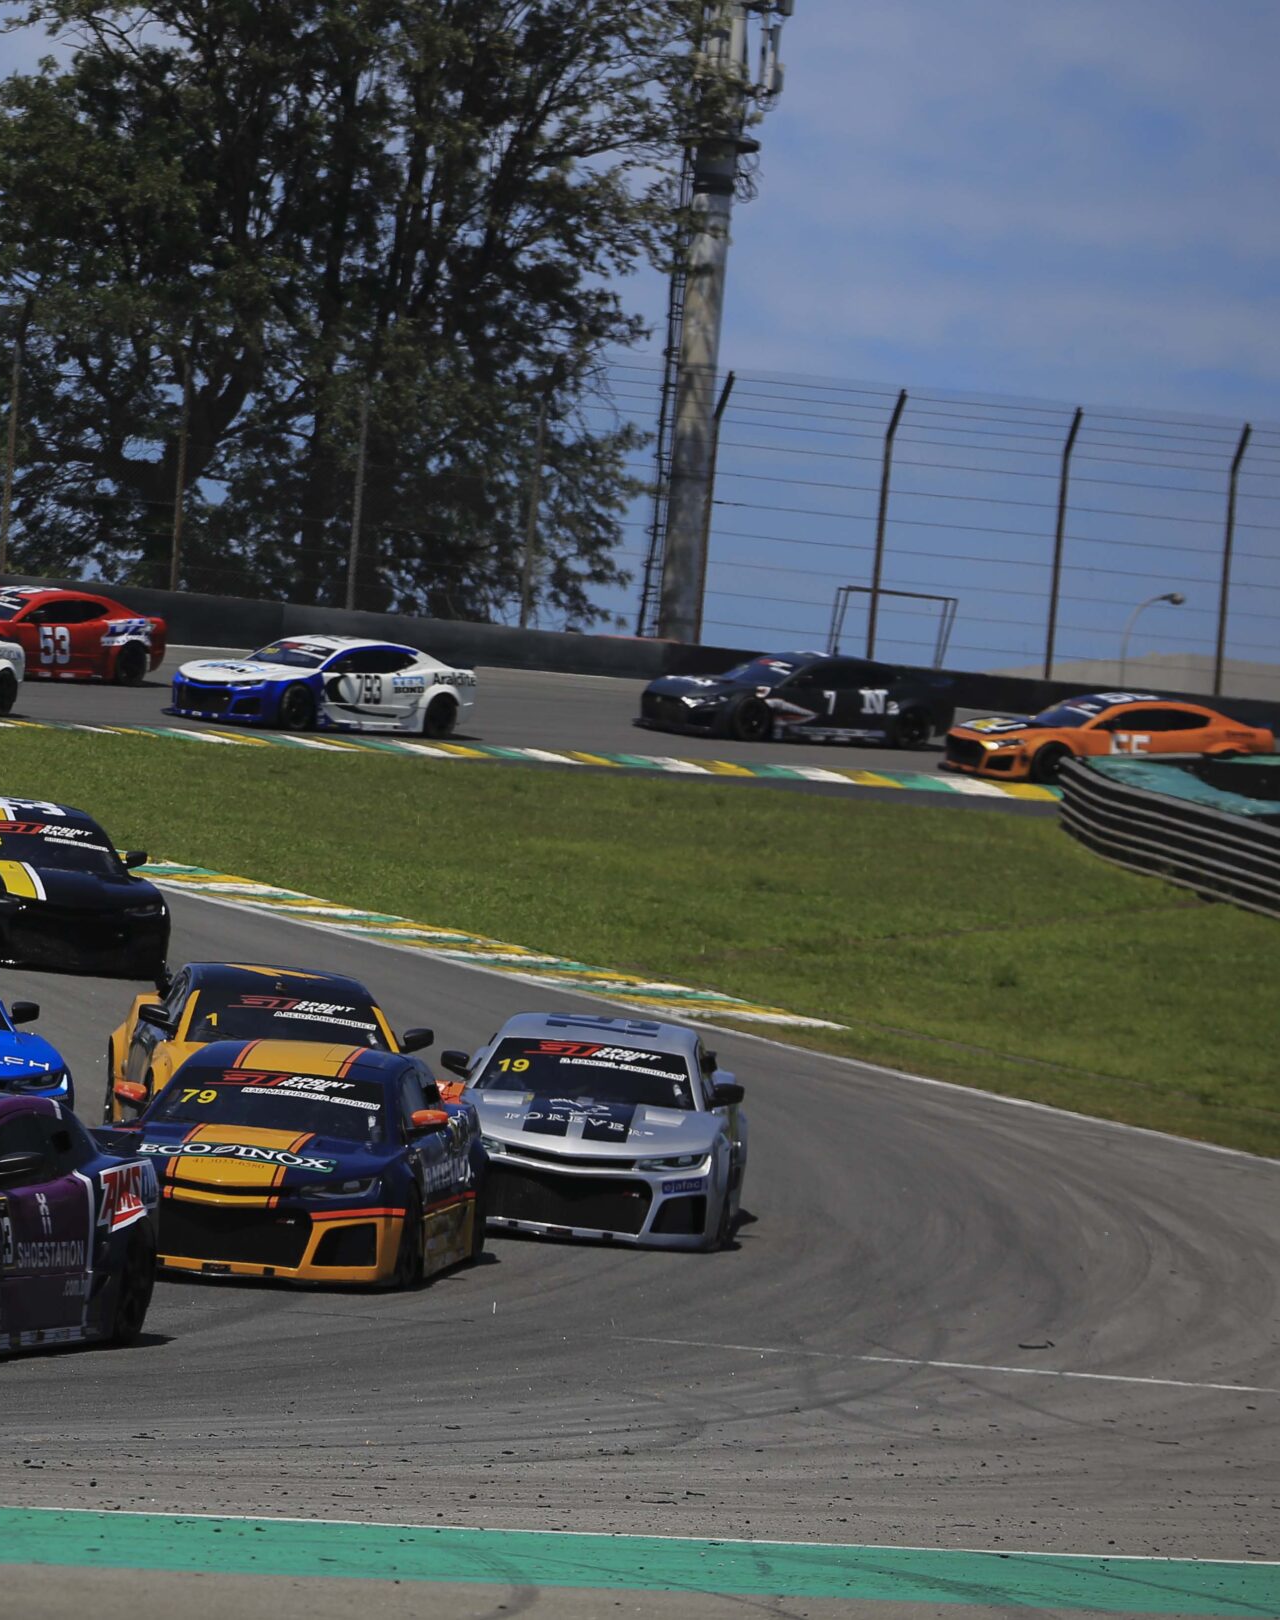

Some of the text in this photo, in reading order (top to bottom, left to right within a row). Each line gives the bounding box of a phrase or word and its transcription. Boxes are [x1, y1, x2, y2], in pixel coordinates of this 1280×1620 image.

[39, 625, 71, 665] 53
[823, 690, 838, 715] 7
[42, 824, 94, 837] SPRINT
[292, 1004, 335, 1015] RACE
[299, 1000, 357, 1013] SPRINT
[205, 1012, 219, 1026] 1
[590, 1050, 638, 1063] RACE
[597, 1046, 662, 1062] SPRINT
[497, 1058, 531, 1073] 19
[278, 1080, 327, 1092] RACE
[288, 1075, 357, 1090] SPRINT
[179, 1088, 219, 1105] 79
[17, 1240, 85, 1268] SHOESTATION
